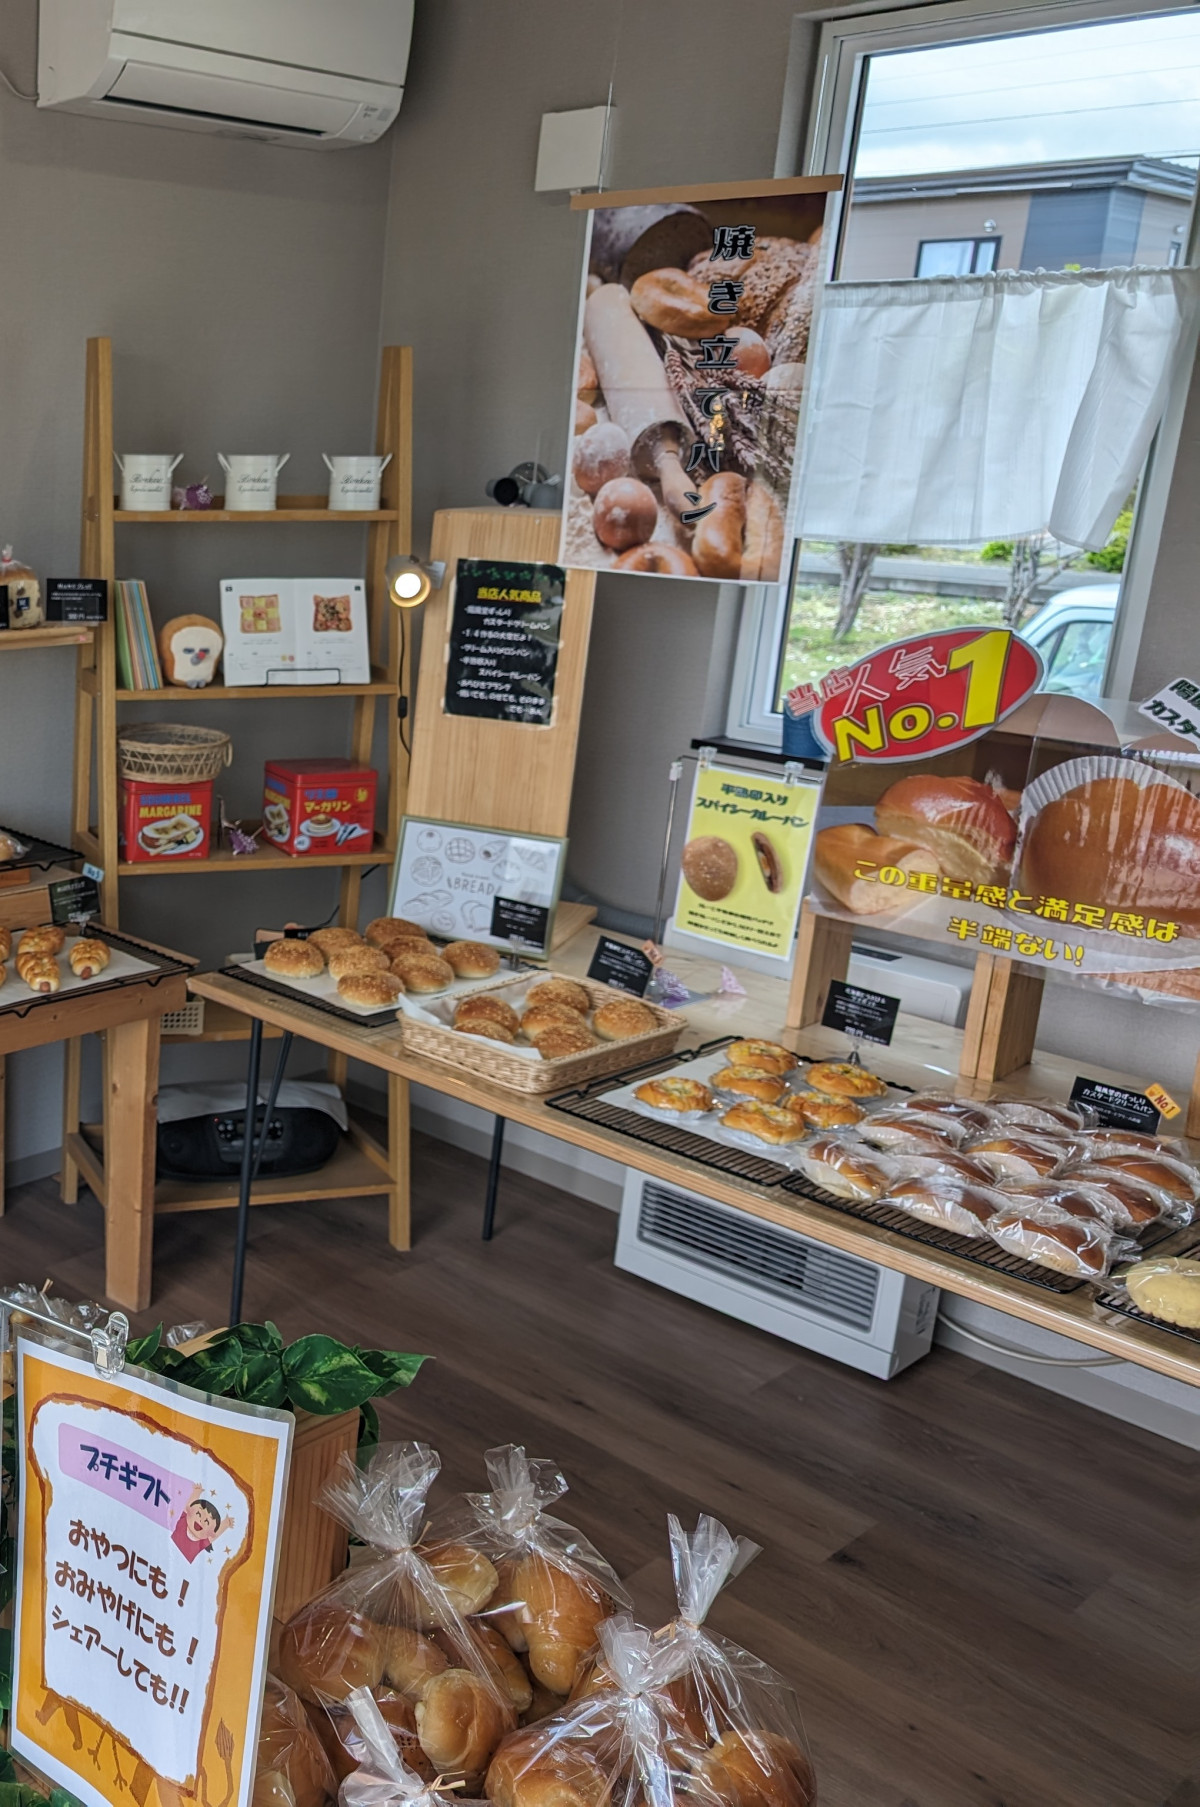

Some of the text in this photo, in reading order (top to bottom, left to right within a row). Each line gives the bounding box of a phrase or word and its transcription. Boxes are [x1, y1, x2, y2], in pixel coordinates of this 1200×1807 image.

[679, 223, 757, 525] 焼き立てパン
[477, 586, 542, 603] 当店人気商品
[787, 646, 949, 716] 当店人気
[833, 629, 1014, 763] No.1
[139, 804, 202, 818] MARGARINE
[304, 801, 351, 813] マーガリン
[696, 797, 809, 828] スパイシーカレーパン
[454, 878, 496, 895] BREAD
[852, 859, 1180, 943] この重量感と満足感は
[947, 916, 1085, 967] 半端ない!
[1082, 1088, 1154, 1114] カスタードクリームパン
[1154, 1094, 1176, 1114] No.1
[80, 1444, 171, 1507] プチギフト
[68, 1518, 190, 1607] おやつにも！
[54, 1560, 199, 1665] おみやげにも！
[51, 1605, 190, 1714] シェアーしても!!
